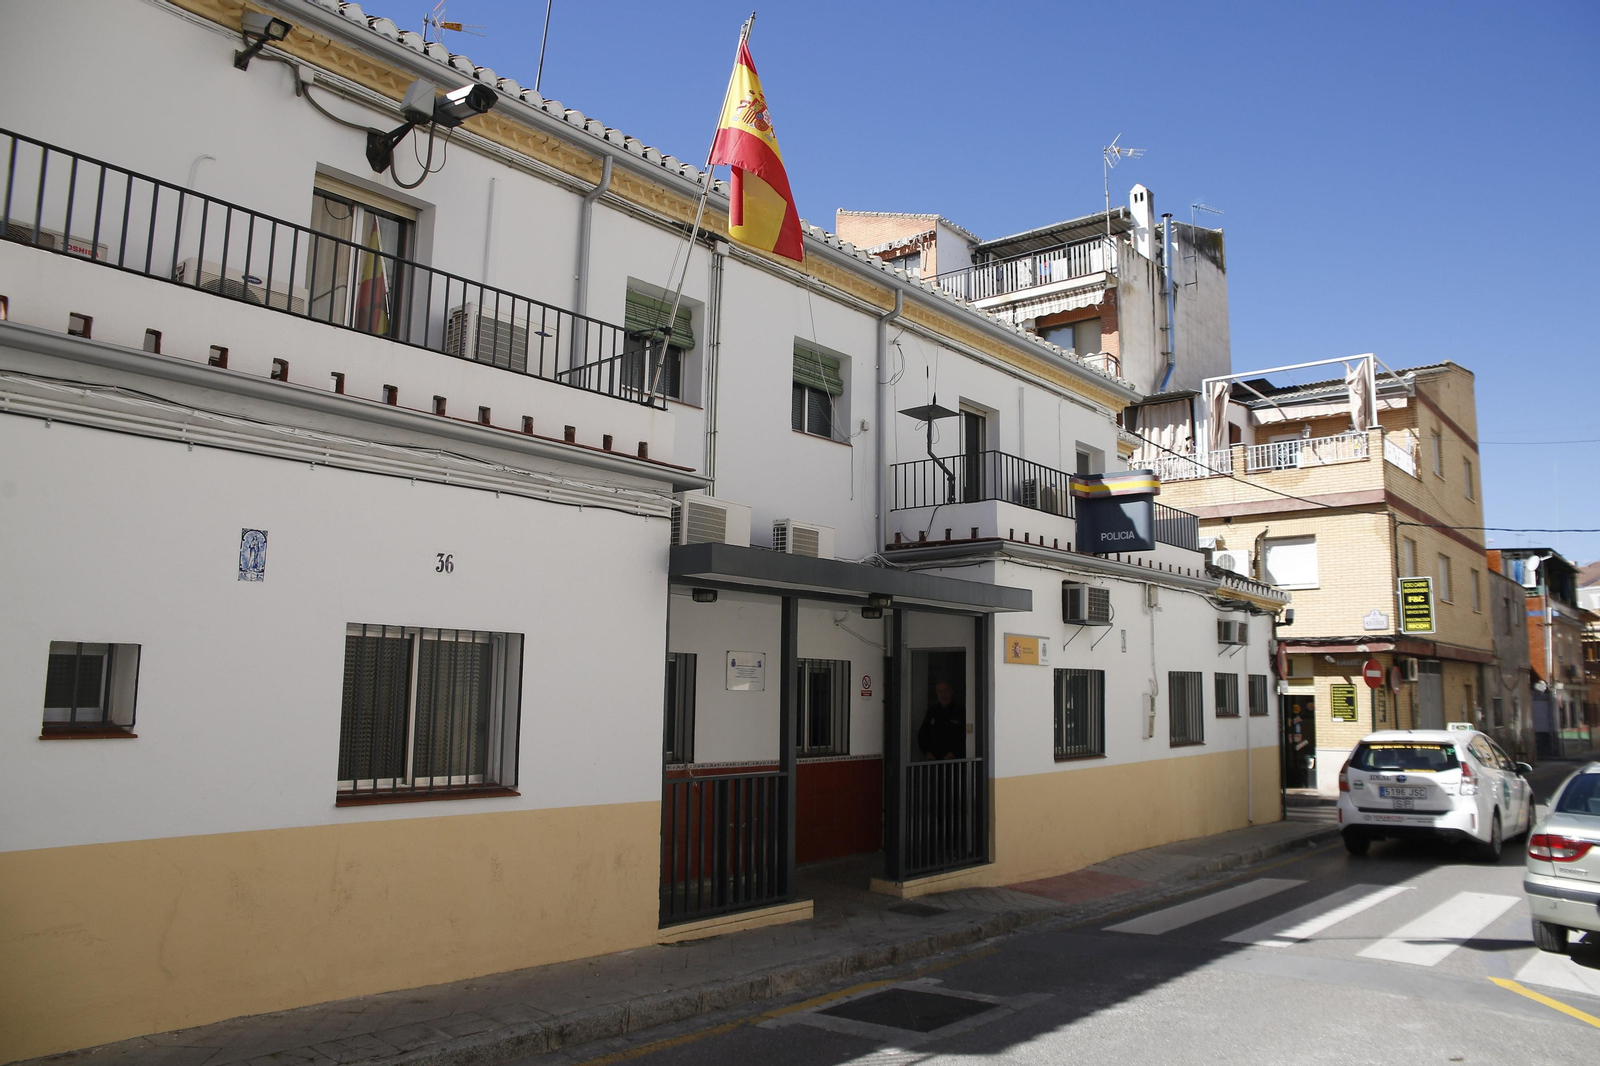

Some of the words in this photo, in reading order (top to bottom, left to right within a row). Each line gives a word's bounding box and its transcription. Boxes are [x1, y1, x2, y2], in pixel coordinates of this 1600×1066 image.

[1101, 531, 1135, 541] POLICIA
[435, 553, 454, 574] 36
[1385, 788, 1406, 796] 5196
[1409, 788, 1425, 797] JSC
